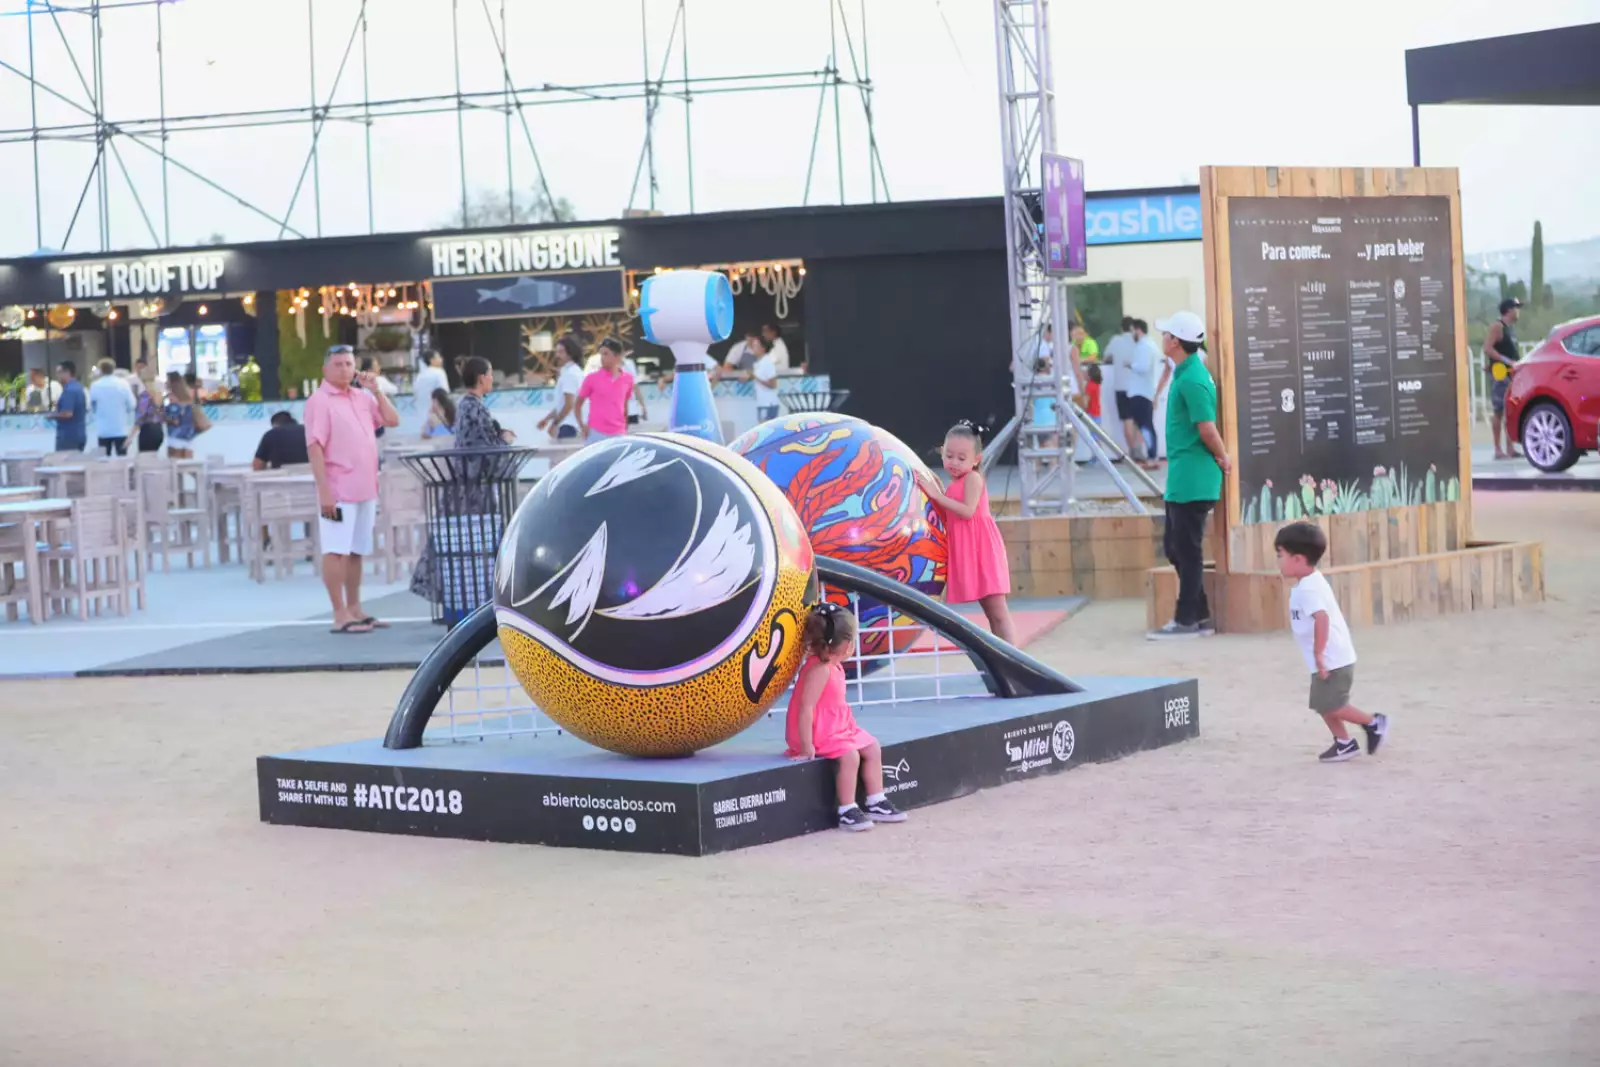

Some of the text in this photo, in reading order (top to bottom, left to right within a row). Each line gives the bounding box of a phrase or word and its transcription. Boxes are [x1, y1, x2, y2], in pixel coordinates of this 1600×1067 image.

[431, 232, 621, 277] HERRINGBONE
[1262, 241, 1331, 260] Para comer...
[1374, 243, 1396, 260] para
[1397, 238, 1425, 256] beber
[58, 256, 225, 299] THE ROOFTOP
[1028, 726, 1037, 734] DE
[1022, 735, 1051, 760] Mifel
[276, 778, 347, 793] TAKE A SELFIE AND
[278, 791, 348, 807] SHARE IT WITH US!
[353, 783, 463, 815] #ATC2018
[542, 792, 677, 813] abiertoloscabos.com
[713, 798, 740, 815] GABRIEL
[740, 793, 764, 809] GUERRA
[736, 813, 744, 825] LA
[743, 810, 758, 824] FIERA
